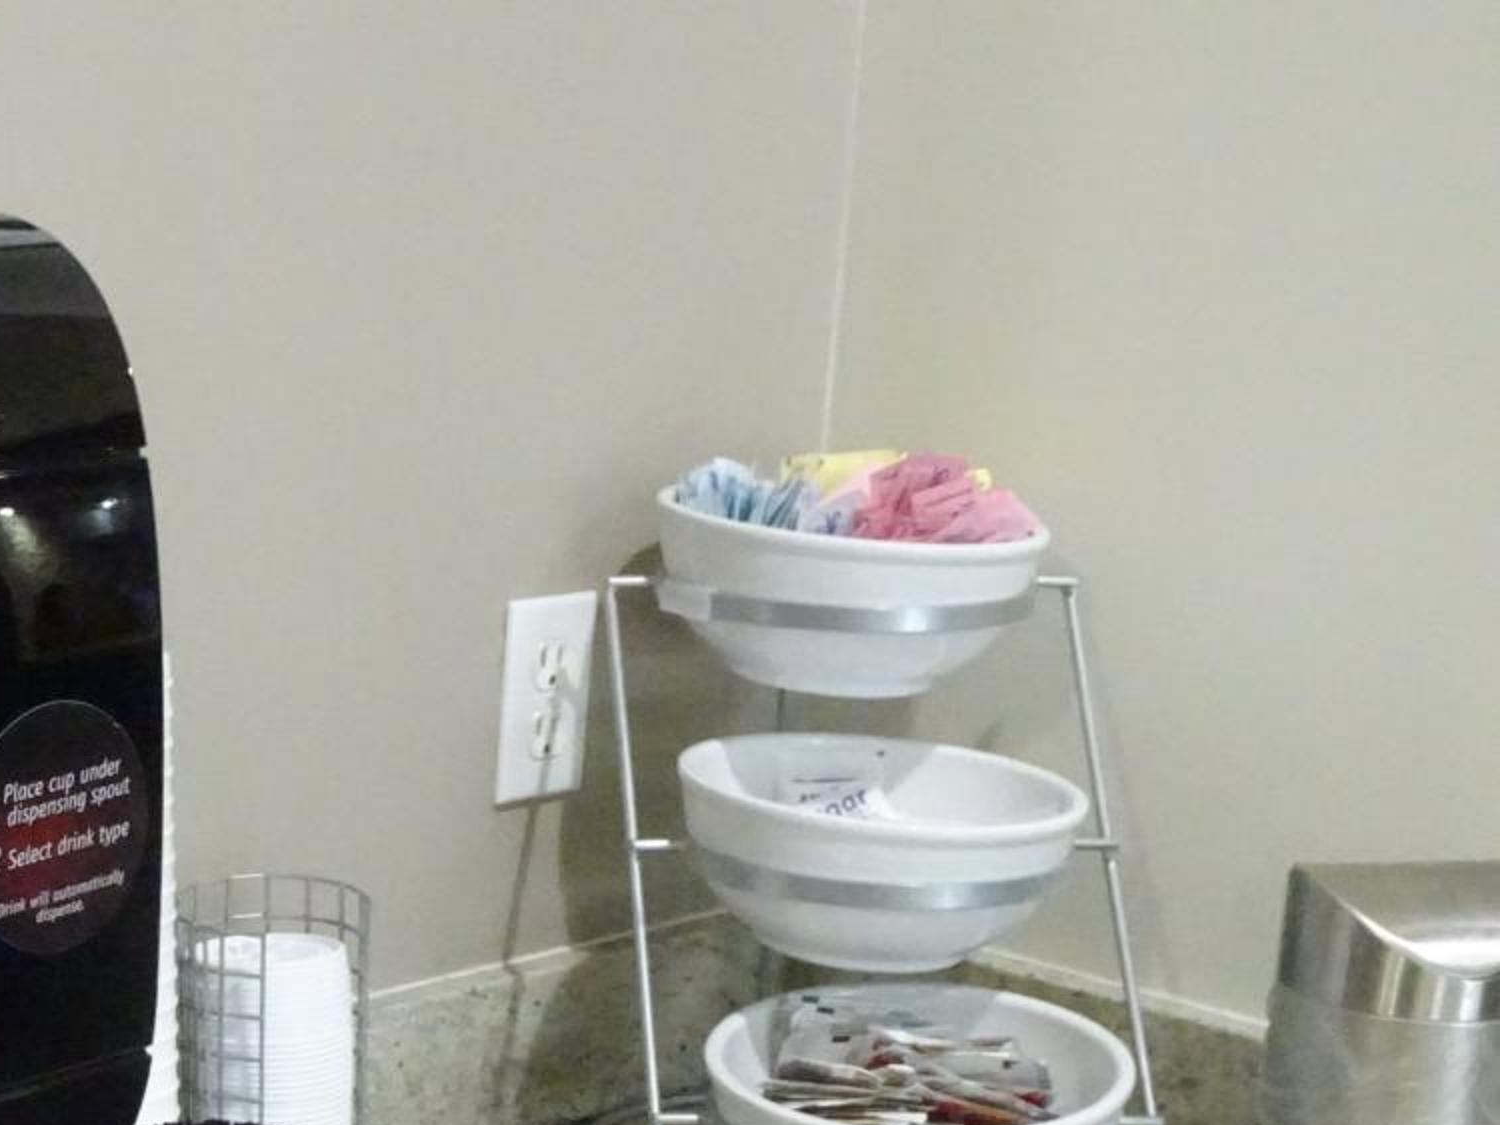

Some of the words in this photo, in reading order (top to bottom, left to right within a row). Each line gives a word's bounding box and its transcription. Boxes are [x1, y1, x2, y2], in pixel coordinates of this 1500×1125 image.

[3, 780, 44, 804] Place
[49, 772, 75, 794] cup
[81, 757, 122, 782] under
[7, 791, 87, 827] dispensing
[91, 777, 131, 805] spout
[7, 841, 54, 870] Select
[57, 827, 95, 856] drink
[100, 821, 130, 846] type
